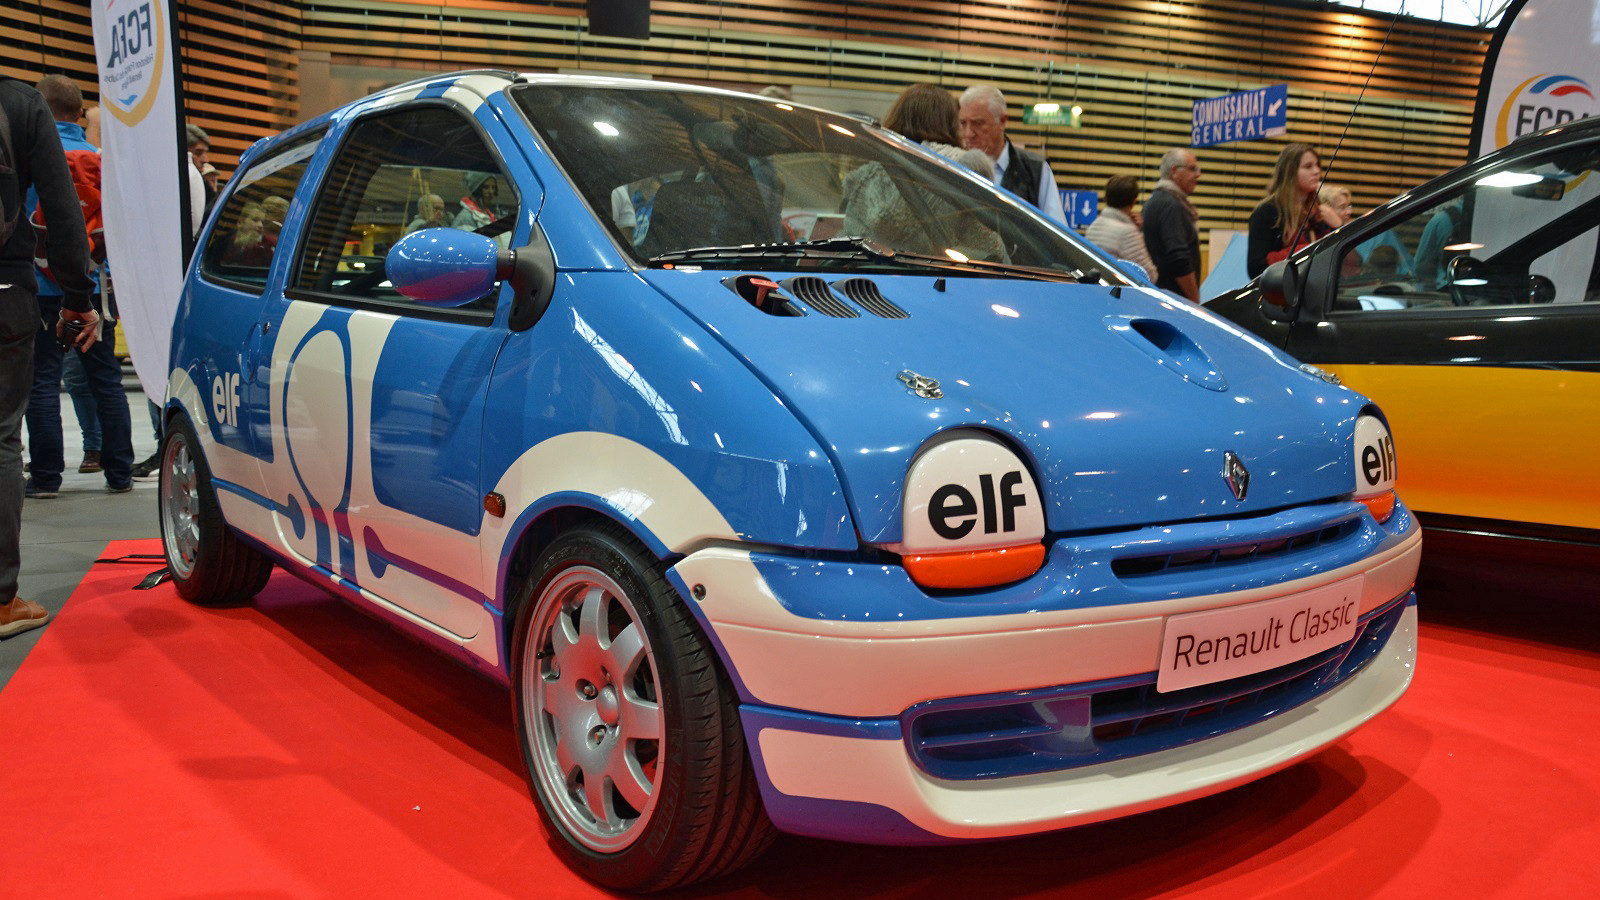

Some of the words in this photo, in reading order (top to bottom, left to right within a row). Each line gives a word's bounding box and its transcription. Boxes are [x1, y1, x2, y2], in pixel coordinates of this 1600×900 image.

[1192, 90, 1266, 127] COMMISSARIAT
[1192, 117, 1265, 145] GENERAL
[212, 372, 240, 427] elf
[1362, 435, 1393, 486] elf
[928, 470, 1026, 540] elf
[1173, 617, 1283, 670] Renault
[1289, 597, 1355, 643] Classic
